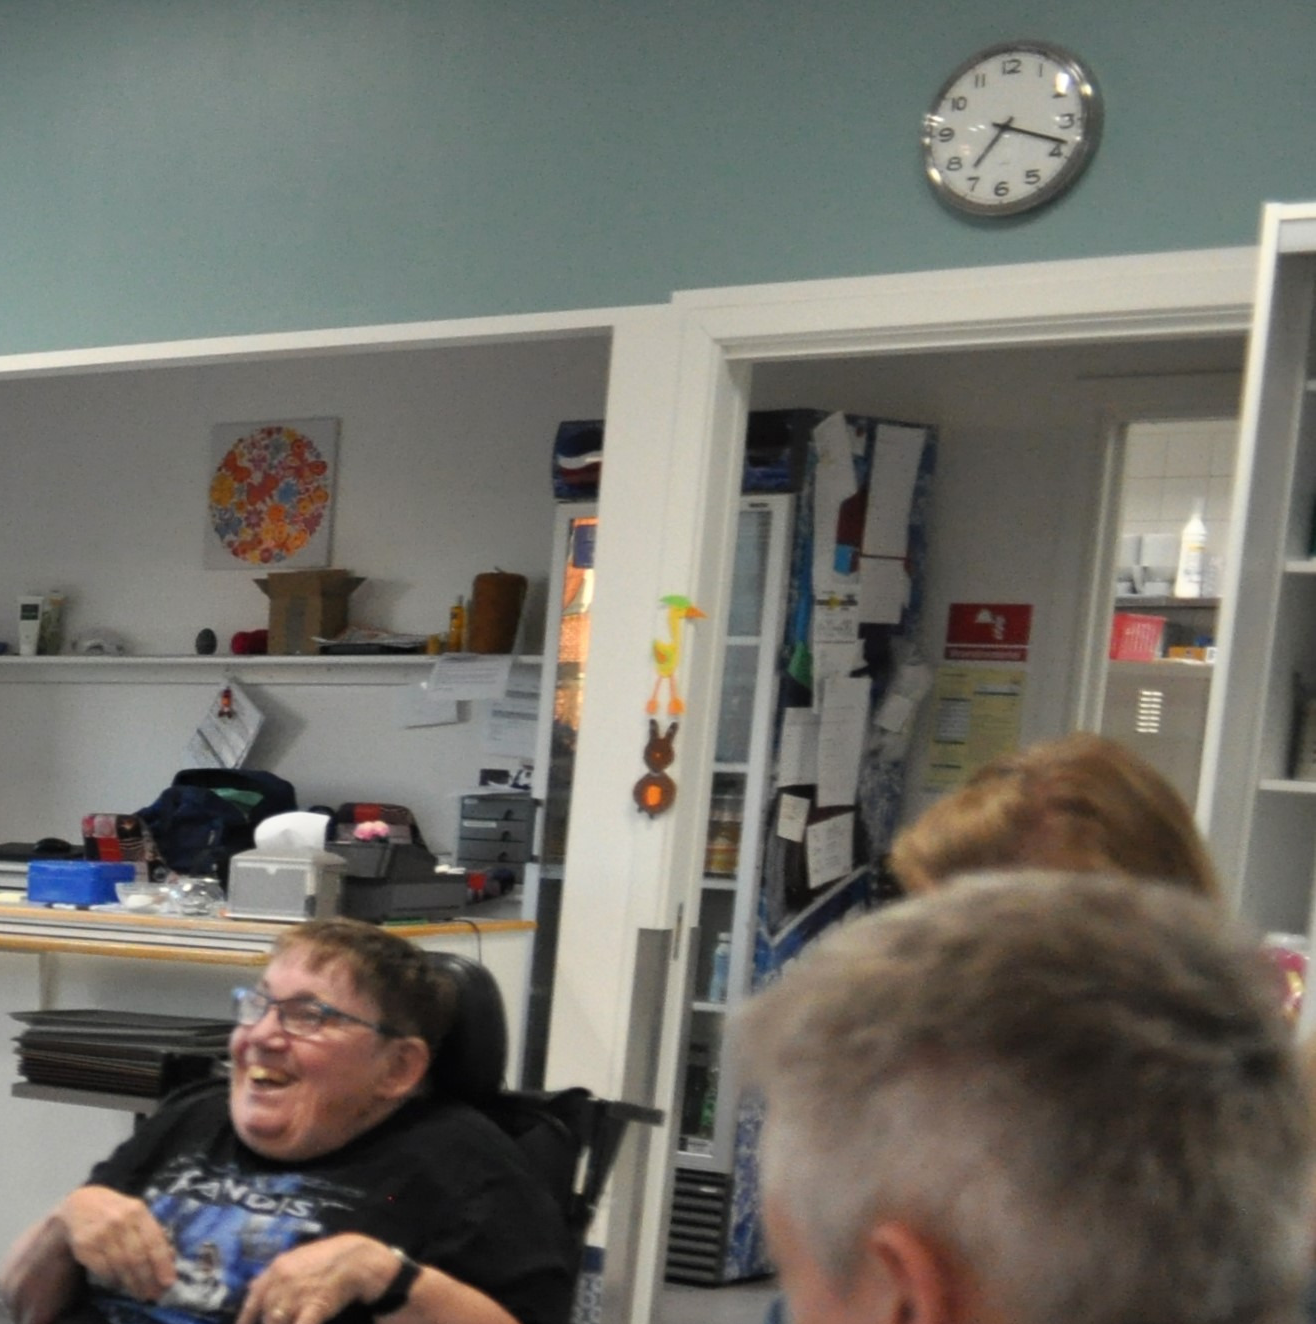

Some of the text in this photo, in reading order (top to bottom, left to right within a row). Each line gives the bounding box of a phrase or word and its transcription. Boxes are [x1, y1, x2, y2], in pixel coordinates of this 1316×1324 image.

[1002, 59, 1022, 74] 12
[975, 74, 985, 88] 11
[951, 97, 967, 111] 10
[1059, 113, 1075, 129] 3
[939, 127, 954, 142] 9
[1048, 143, 1063, 157] 4
[947, 156, 962, 171] 8
[967, 177, 980, 192] 7
[1025, 170, 1040, 185] 5
[994, 181, 1009, 197] 6
